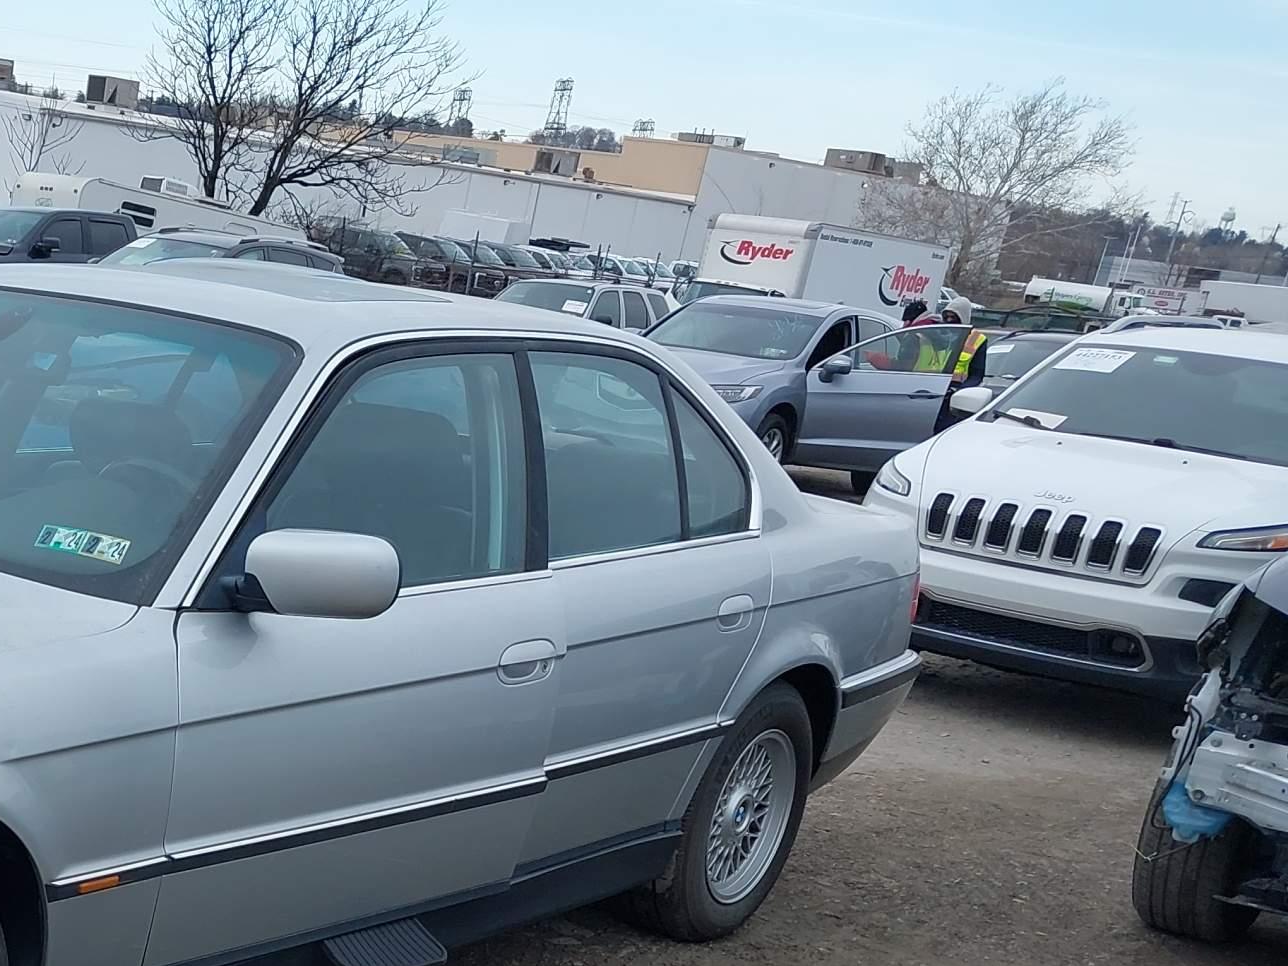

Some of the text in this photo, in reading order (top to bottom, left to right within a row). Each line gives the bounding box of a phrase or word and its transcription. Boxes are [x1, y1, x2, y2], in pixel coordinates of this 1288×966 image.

[736, 240, 793, 260] Ryder
[889, 265, 930, 297] Ryder
[1033, 490, 1074, 503] Jeep
[40, 531, 84, 550] 2 24
[86, 536, 128, 560] 2 24
